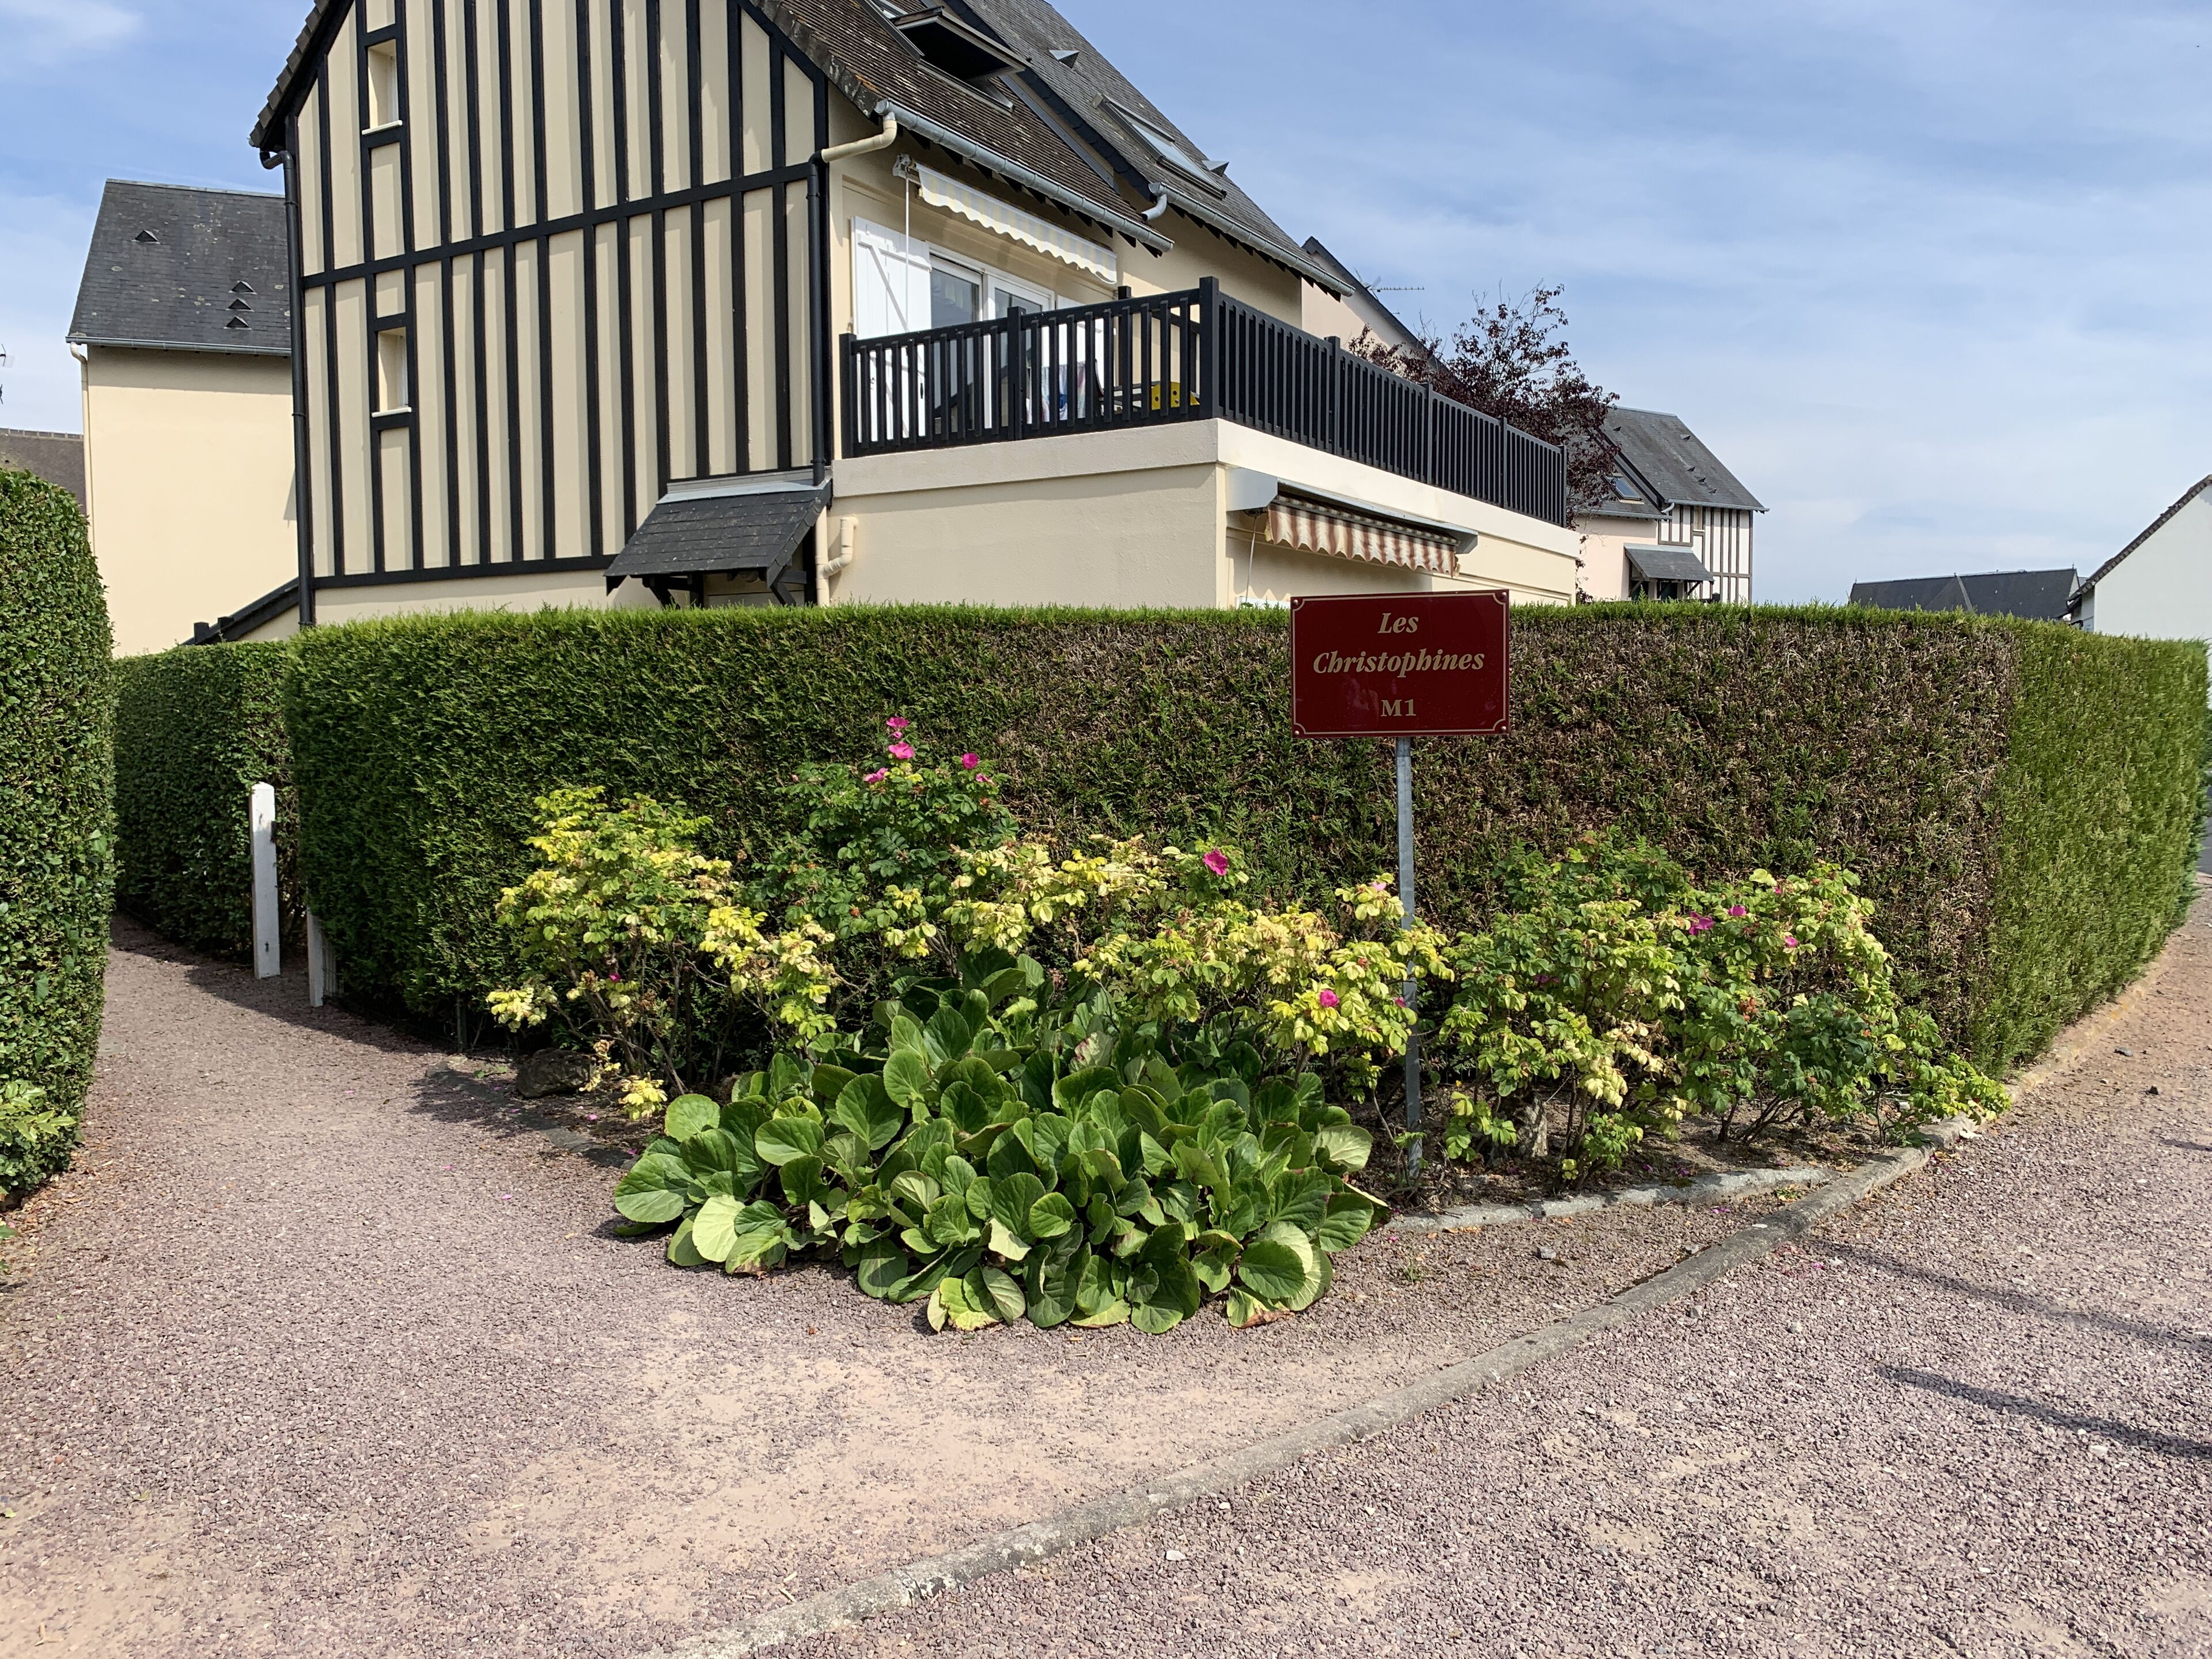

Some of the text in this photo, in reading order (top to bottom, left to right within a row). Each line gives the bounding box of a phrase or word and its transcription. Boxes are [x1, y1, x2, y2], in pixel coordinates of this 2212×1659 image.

[1377, 612, 1419, 634] Les
[1313, 648, 1485, 678] Christophines
[1380, 699, 1416, 717] M1
